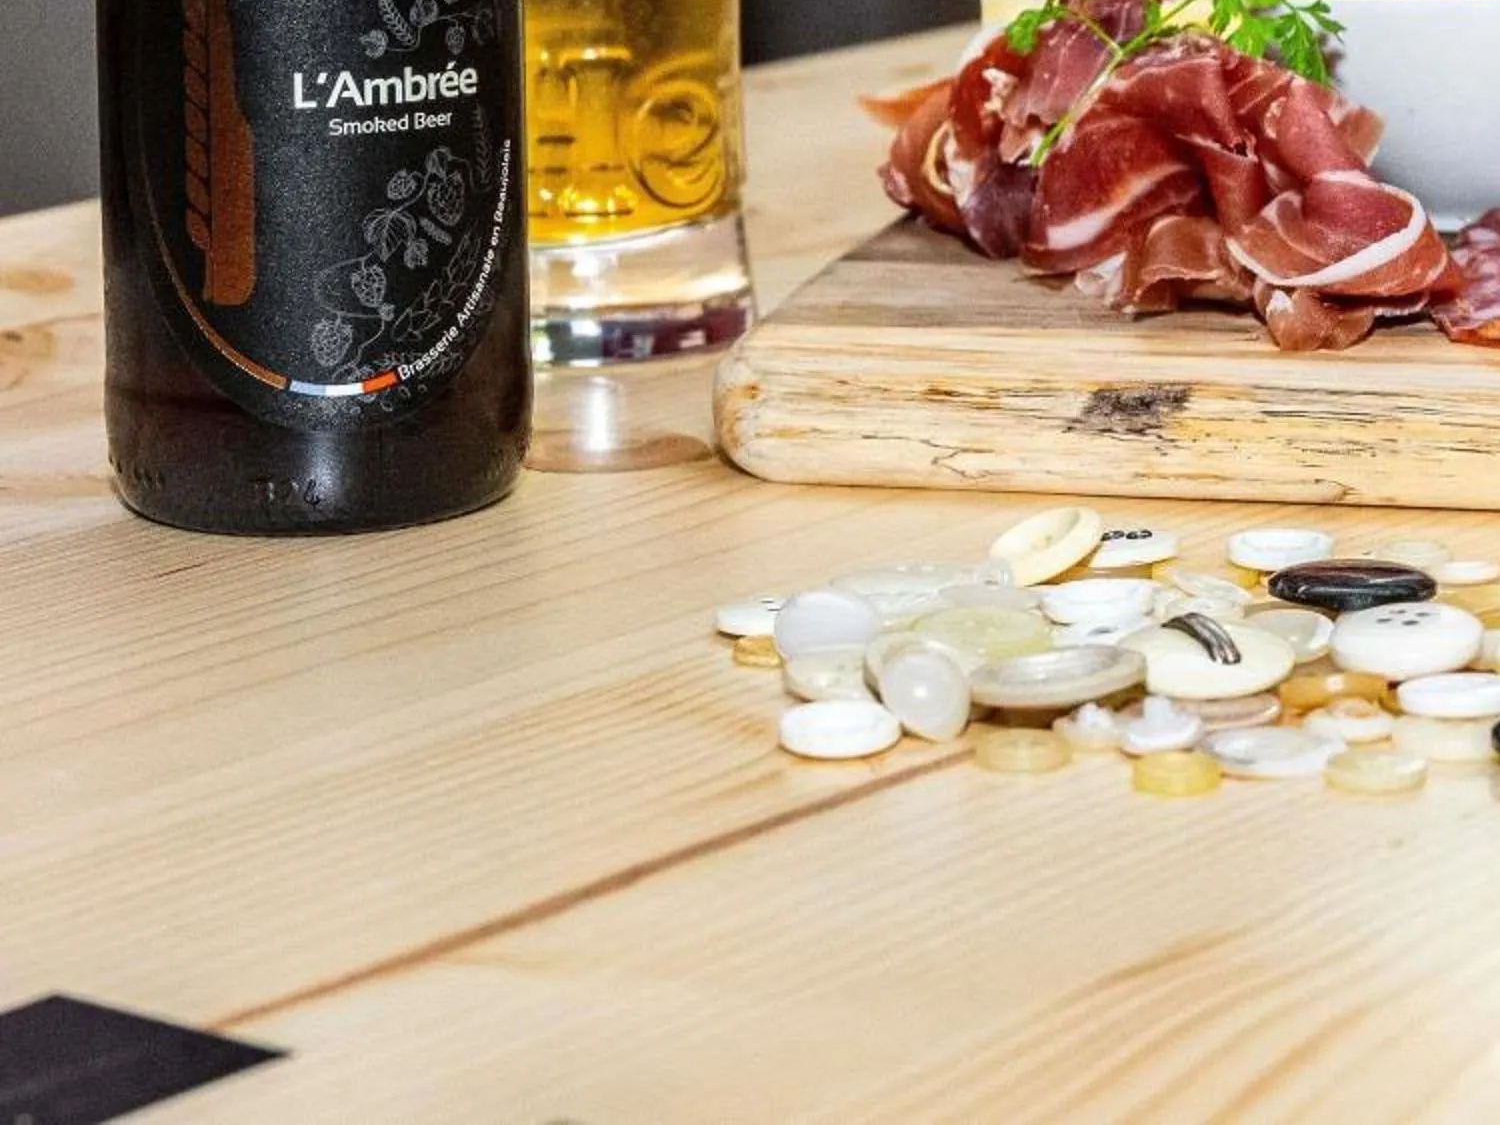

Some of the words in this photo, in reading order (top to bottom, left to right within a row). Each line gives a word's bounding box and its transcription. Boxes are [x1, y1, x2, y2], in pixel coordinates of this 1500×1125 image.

[293, 62, 477, 109] L'Ambrée
[329, 115, 409, 137] Smoked
[414, 112, 452, 132] Beer
[398, 325, 459, 380] Brasserie
[456, 248, 495, 327] Artisanale
[491, 226, 501, 247] en
